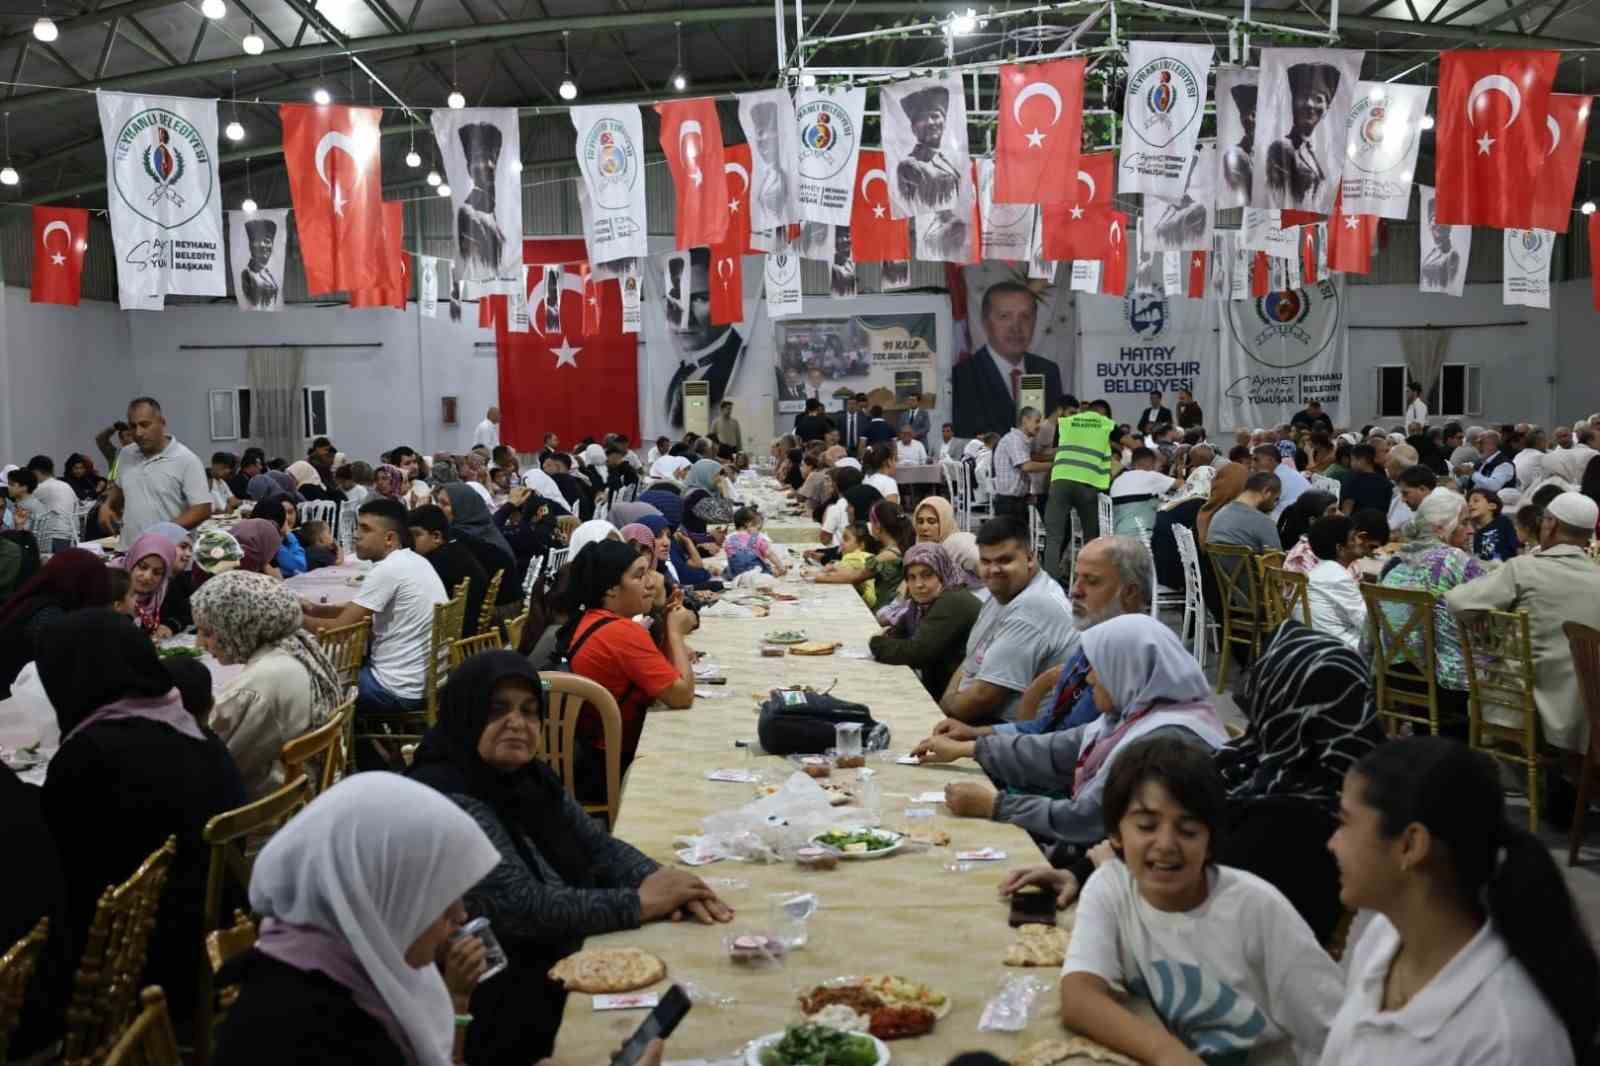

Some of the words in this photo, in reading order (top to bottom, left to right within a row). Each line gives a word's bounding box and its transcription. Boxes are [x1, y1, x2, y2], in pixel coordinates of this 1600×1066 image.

[175, 240, 217, 250] REYHANLI
[175, 251, 216, 261] BELEDİYE
[175, 263, 213, 272] BAŞKANI
[1120, 346, 1176, 361] HATAY
[1096, 361, 1201, 377] BÜYÜKŞEHİR
[1104, 377, 1194, 393] BELEDİYESİ
[1252, 375, 1297, 386] AHMET
[1247, 395, 1296, 405] YUMUŞAK
